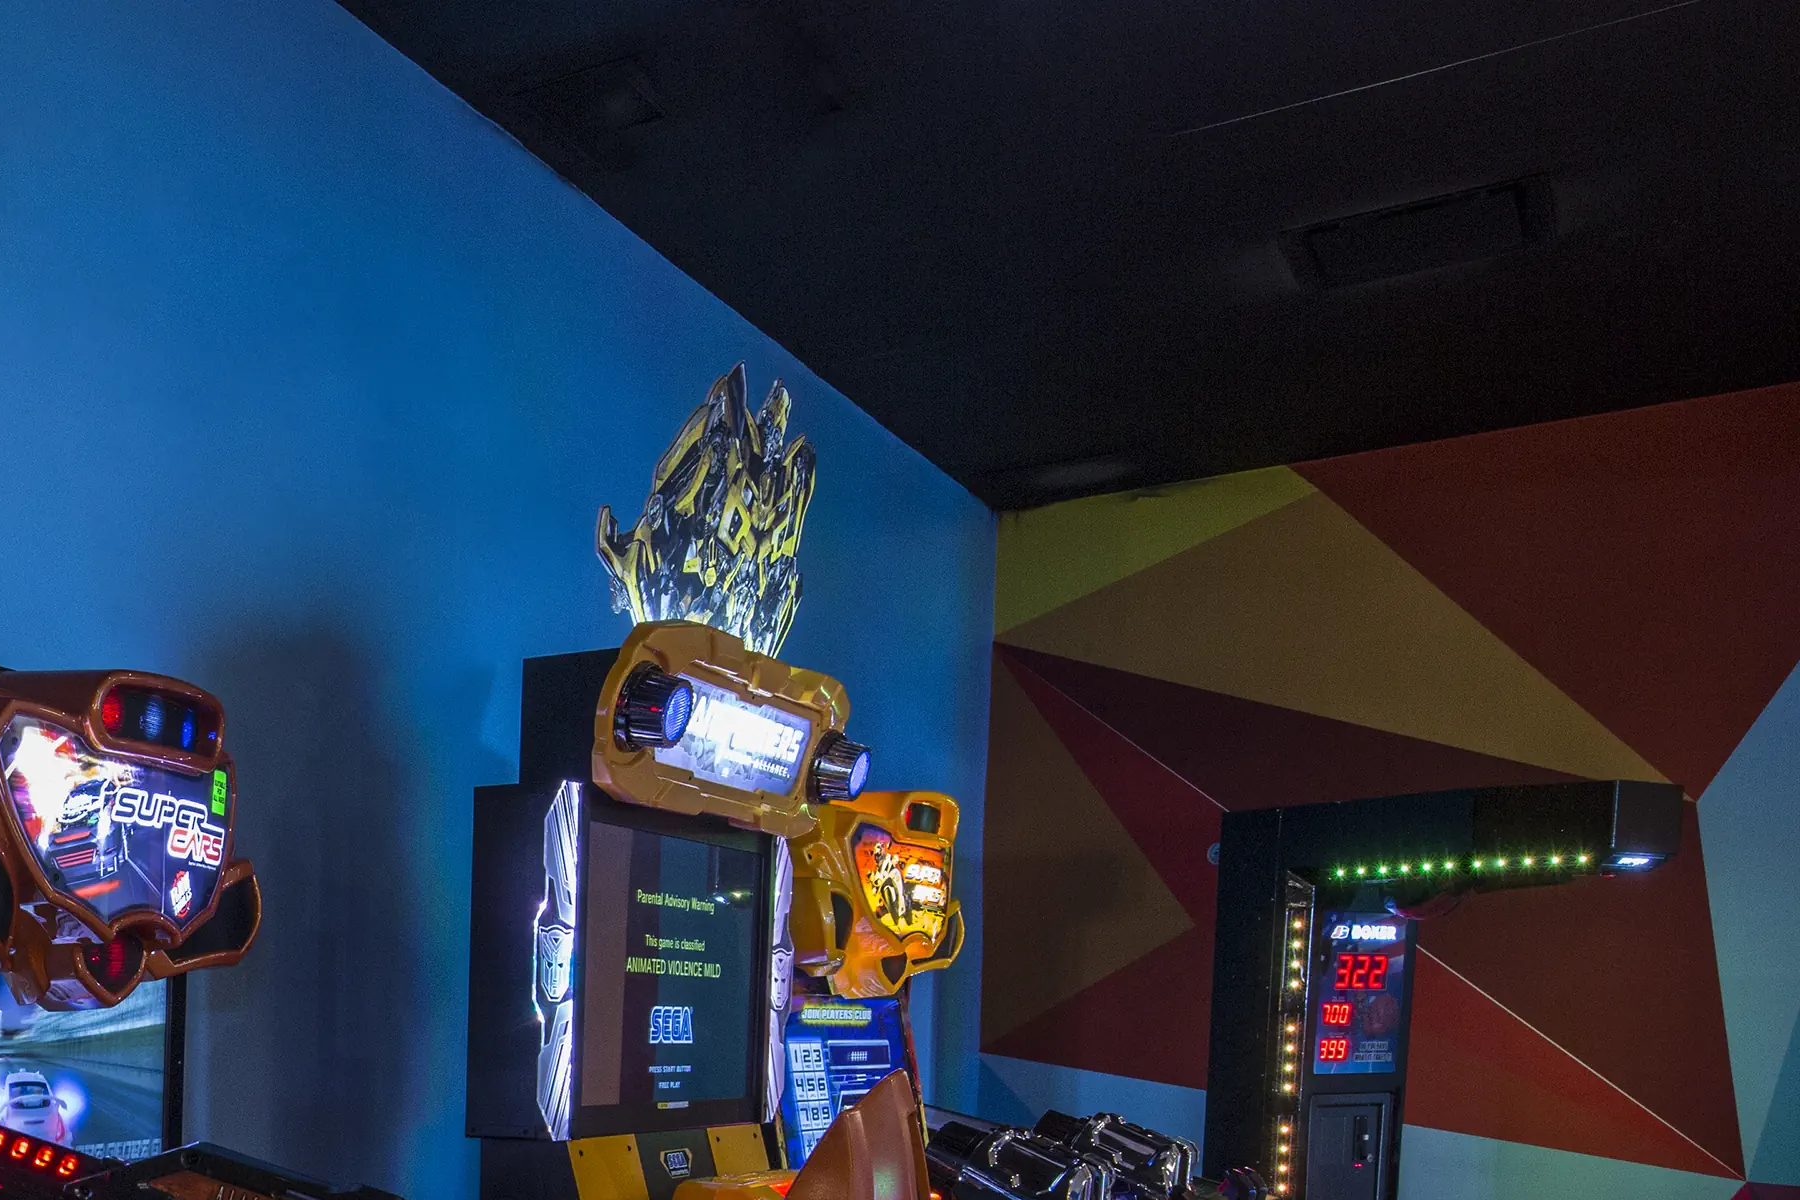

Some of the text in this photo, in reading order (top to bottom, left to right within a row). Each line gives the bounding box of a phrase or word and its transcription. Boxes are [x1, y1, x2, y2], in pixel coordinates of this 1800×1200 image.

[112, 787, 222, 832] SUPER
[167, 827, 224, 866] CARS
[637, 889, 714, 915] Parental Advisory Warning
[1351, 924, 1397, 940] BOXER
[645, 934, 705, 951] This game is classified
[626, 956, 721, 978] ANIMATED VIOLENCE MILD
[1334, 954, 1388, 989] 322
[802, 1008, 872, 1021] JOIN PLAYERS CLUB
[1323, 1004, 1350, 1024] 700
[650, 1006, 693, 1044] SEGA
[803, 1050, 811, 1062] 2
[813, 1049, 821, 1062] 3
[1320, 1039, 1347, 1059] 399
[795, 1078, 825, 1092] 4 5 6
[800, 1107, 830, 1121] 7 8 9
